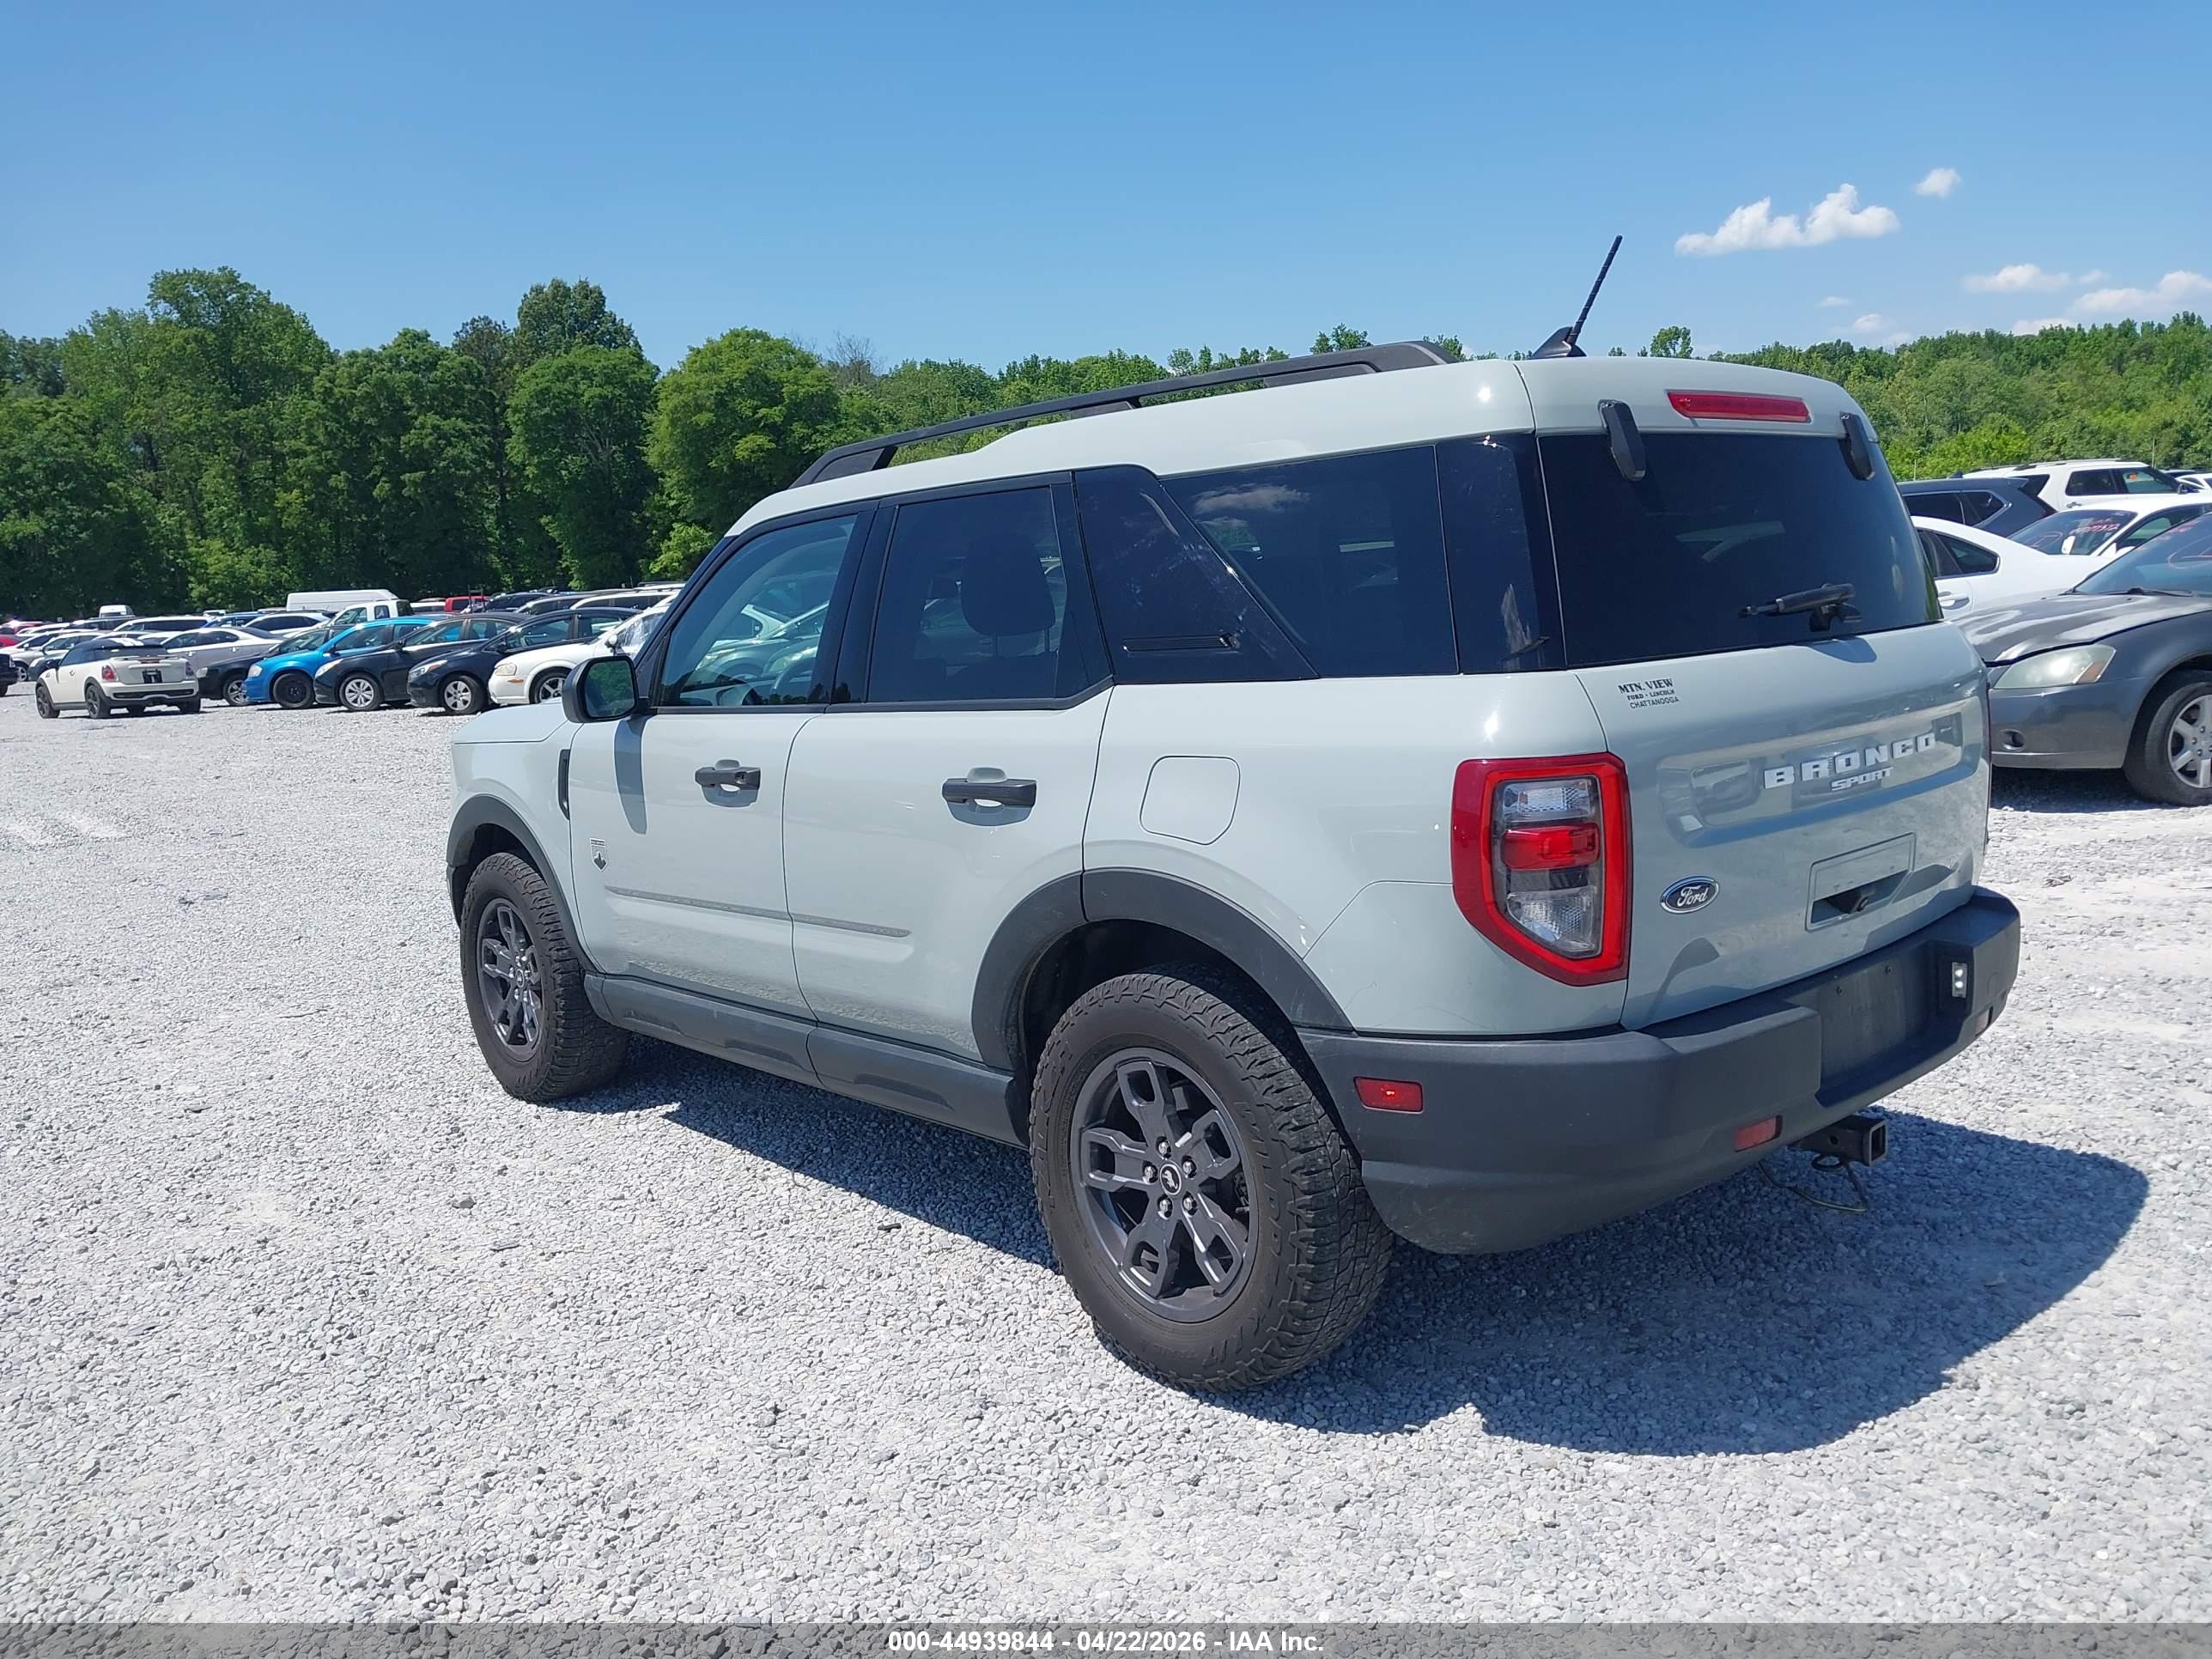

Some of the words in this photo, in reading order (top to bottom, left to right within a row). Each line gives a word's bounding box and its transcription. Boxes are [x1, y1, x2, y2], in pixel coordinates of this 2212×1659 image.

[1618, 683, 1646, 693] MTN.
[1645, 678, 1673, 689] VIEW
[1630, 696, 1679, 708] CHATTANOOGA
[1764, 732, 1936, 789] BRONCO
[1831, 766, 1894, 791] SPORT
[1676, 884, 1710, 907] Ford
